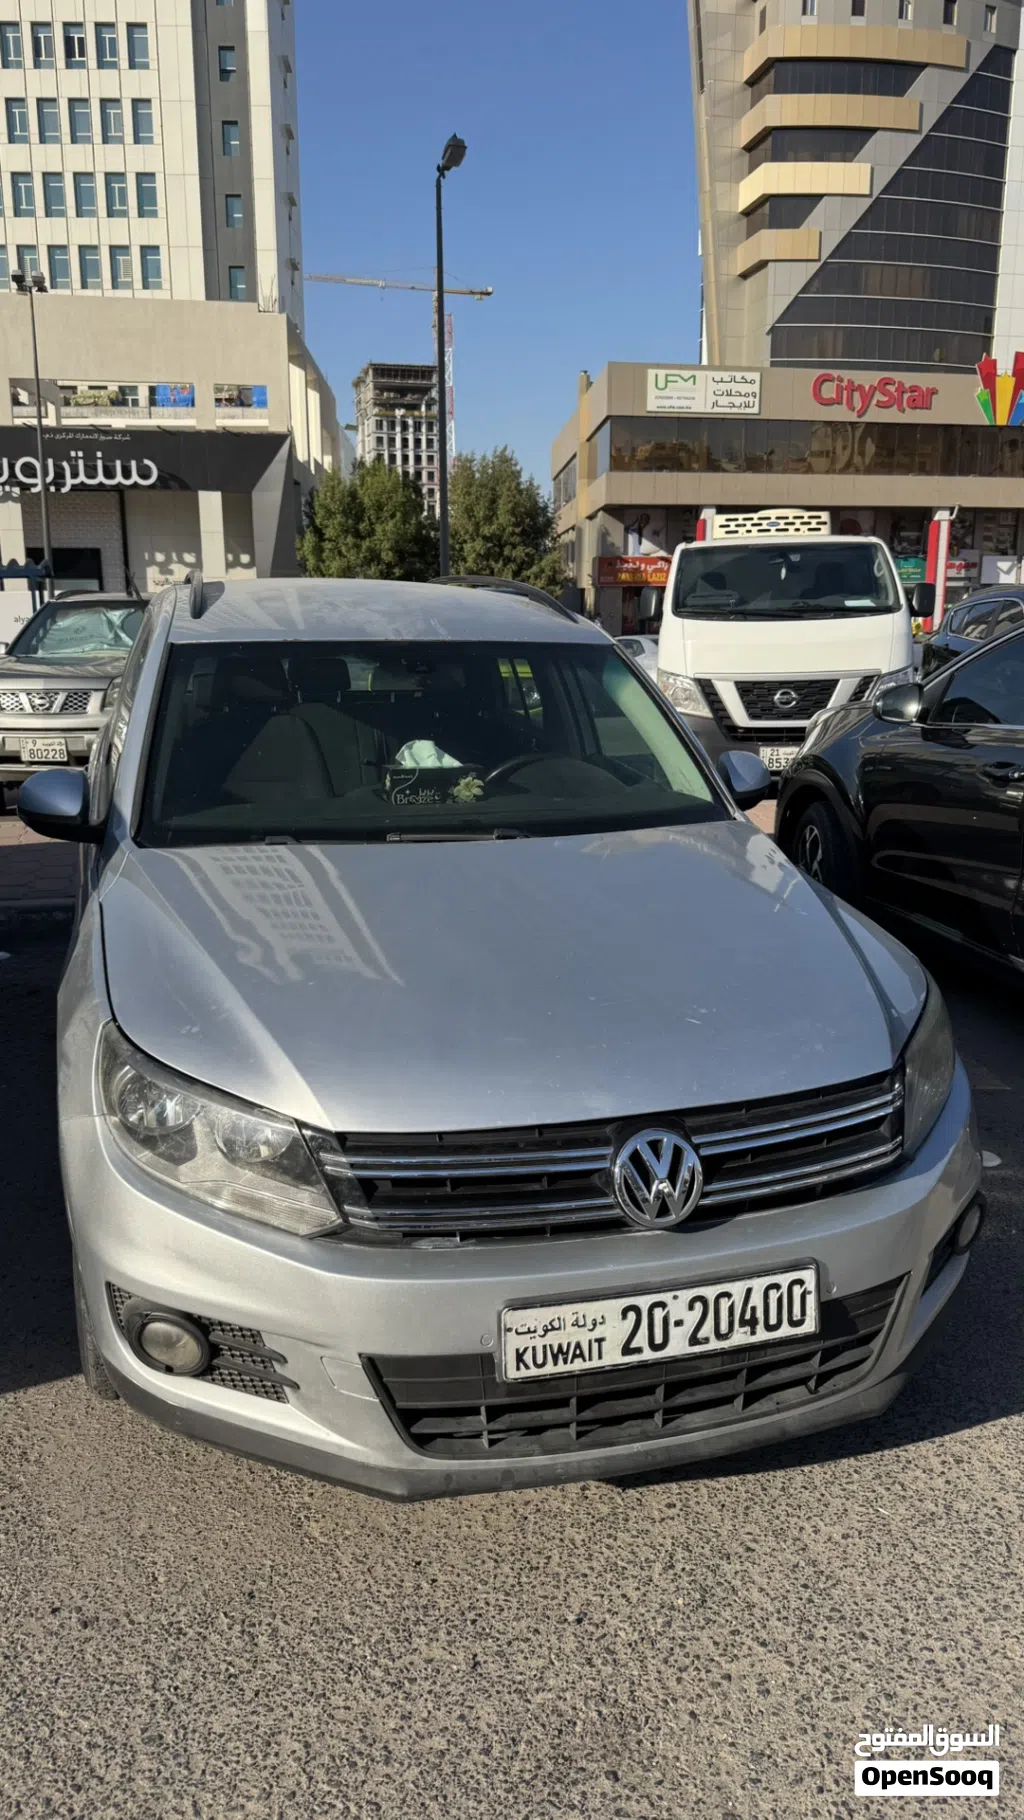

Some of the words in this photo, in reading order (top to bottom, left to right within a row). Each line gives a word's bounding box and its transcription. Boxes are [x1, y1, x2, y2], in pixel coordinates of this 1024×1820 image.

[655, 373, 696, 391] UFM
[711, 374, 756, 385] مكاتب
[713, 388, 757, 399] ومحلات
[811, 372, 938, 418] CityStar
[31, 739, 37, 747] 9
[28, 748, 66, 760] 80228
[767, 757, 792, 769] 853
[571, 1314, 607, 1333] دولة
[620, 1278, 808, 1357] 20-20400
[514, 1316, 566, 1343] الكويت
[514, 1337, 607, 1372] KUWAIT
